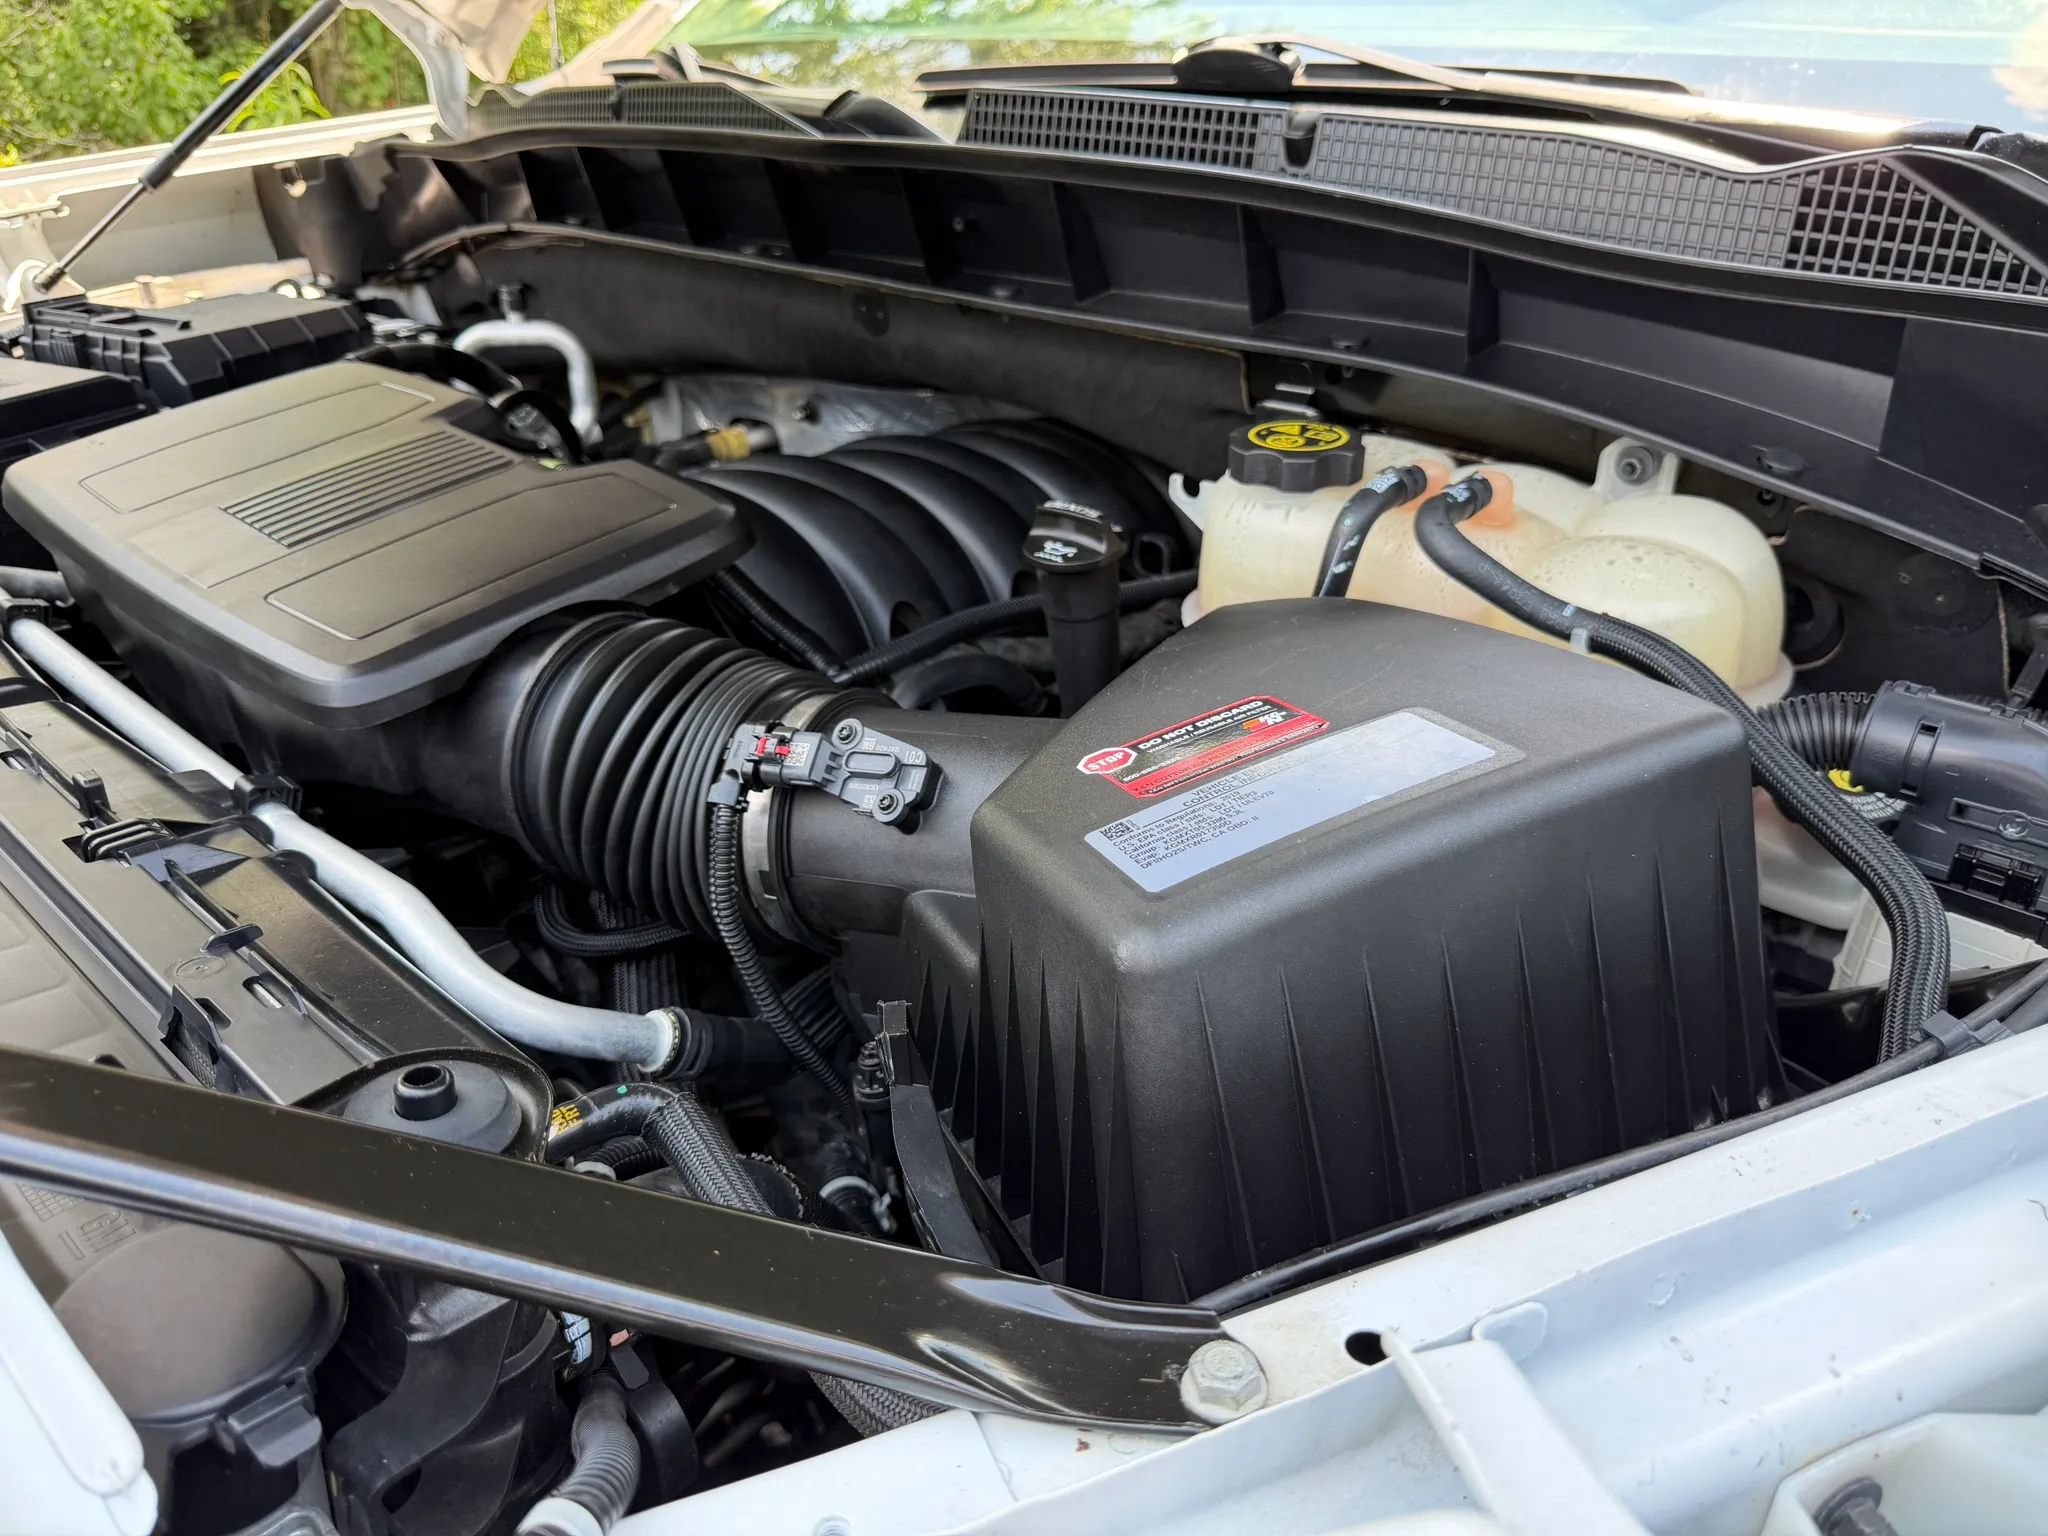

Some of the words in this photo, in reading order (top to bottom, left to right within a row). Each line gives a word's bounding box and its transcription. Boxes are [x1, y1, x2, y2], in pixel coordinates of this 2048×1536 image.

[1137, 738, 1162, 750] DO
[1162, 724, 1194, 740] NOT
[1194, 700, 1264, 728] DISCARD
[1147, 735, 1190, 753] WASHABLE
[1194, 718, 1233, 737] REUSABLE
[1246, 705, 1272, 716] FILTER
[1087, 751, 1125, 771] STOP
[1183, 781, 1237, 808] CONTROL
[1192, 774, 1240, 797] VEHICLE
[1113, 826, 1155, 847] Conforms
[1165, 800, 1217, 825] Regulations:
[1137, 833, 1157, 844] EPA
[1157, 823, 1180, 835] class
[1211, 830, 1227, 838] CA
[1123, 836, 1166, 856] California
[1166, 826, 1189, 838] class
